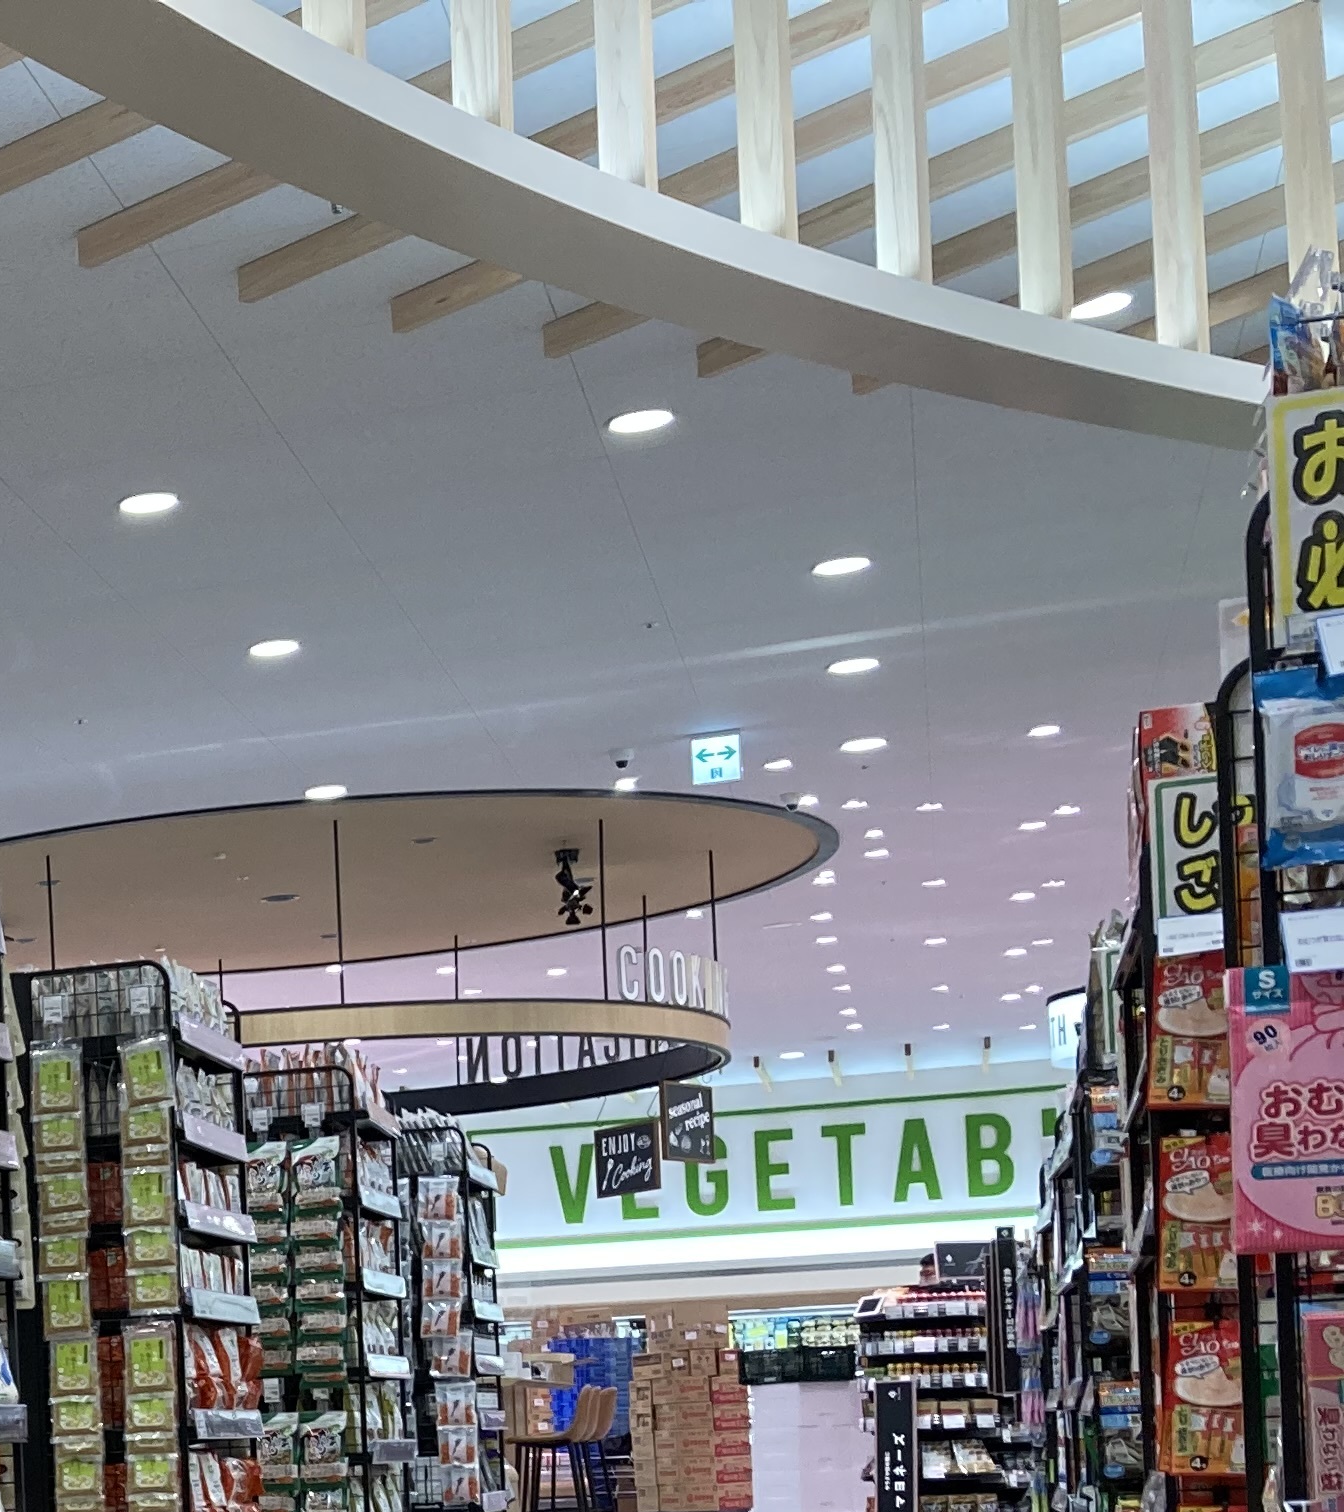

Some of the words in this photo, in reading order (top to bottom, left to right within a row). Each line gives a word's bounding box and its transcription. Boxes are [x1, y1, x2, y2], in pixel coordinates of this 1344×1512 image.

[1258, 969, 1276, 989] S
[1254, 1025, 1278, 1046] 90
[668, 1092, 703, 1119] seasonal
[684, 1111, 711, 1131] recipe
[601, 1131, 636, 1158] ENJOY
[548, 1107, 1056, 1225] VGETAB
[612, 1154, 653, 1190] Cooking
